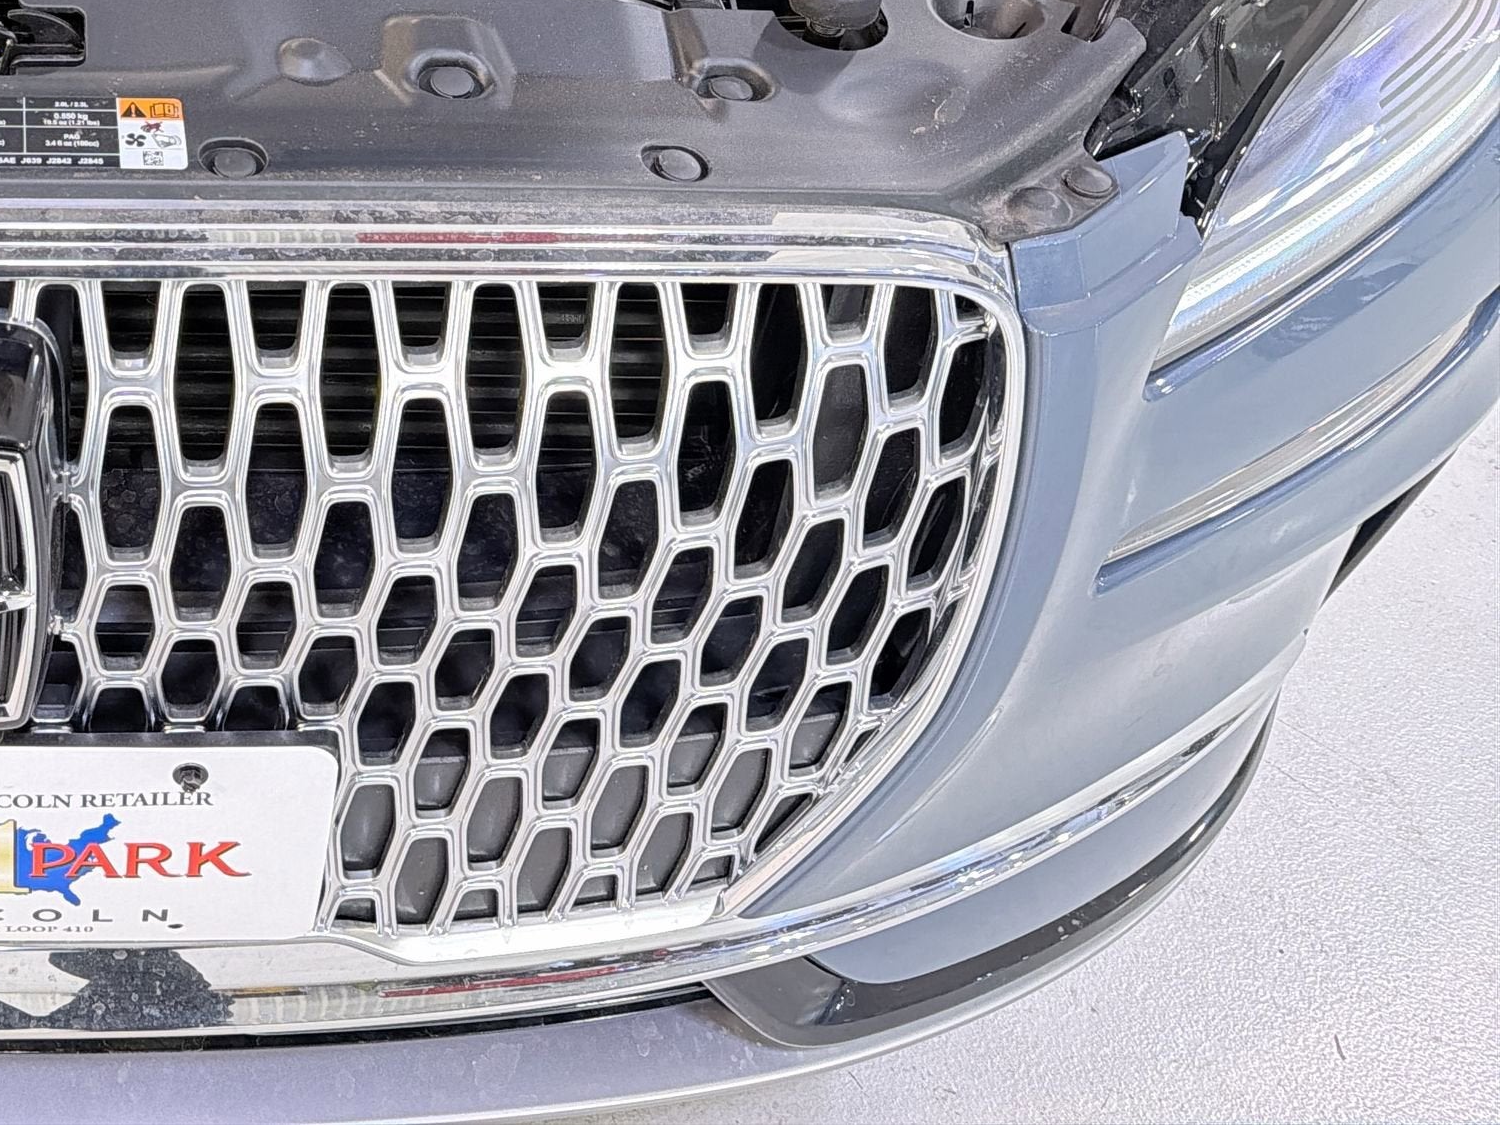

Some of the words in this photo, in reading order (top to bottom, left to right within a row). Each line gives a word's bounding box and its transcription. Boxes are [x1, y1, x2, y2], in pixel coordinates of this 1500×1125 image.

[77, 113, 89, 121] kg
[79, 790, 215, 808] RETAILER
[30, 841, 252, 879] PARK
[5, 925, 58, 933] LOOP
[61, 925, 94, 933] 410
